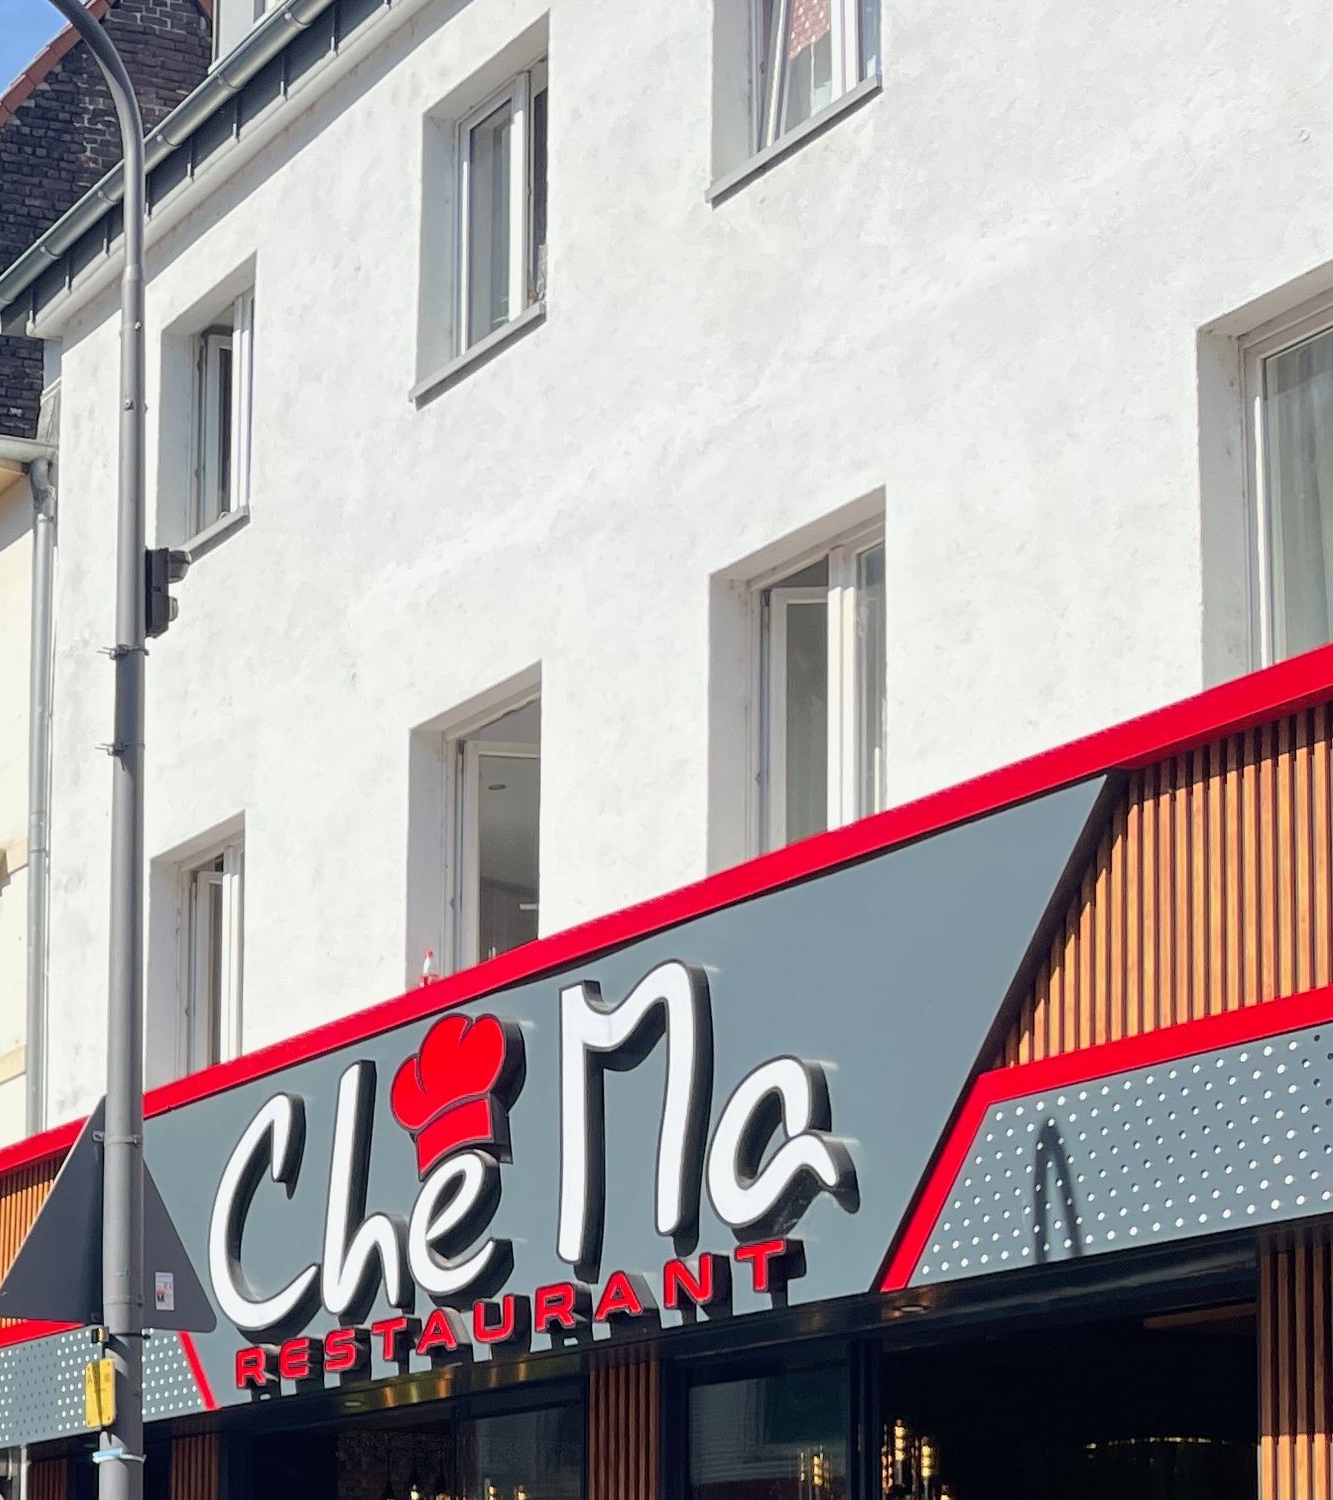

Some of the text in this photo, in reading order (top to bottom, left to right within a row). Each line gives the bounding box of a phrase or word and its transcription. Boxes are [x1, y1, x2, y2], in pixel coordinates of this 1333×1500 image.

[208, 959, 839, 1331] Che Ma
[236, 1238, 786, 1389] RESTAURANT
